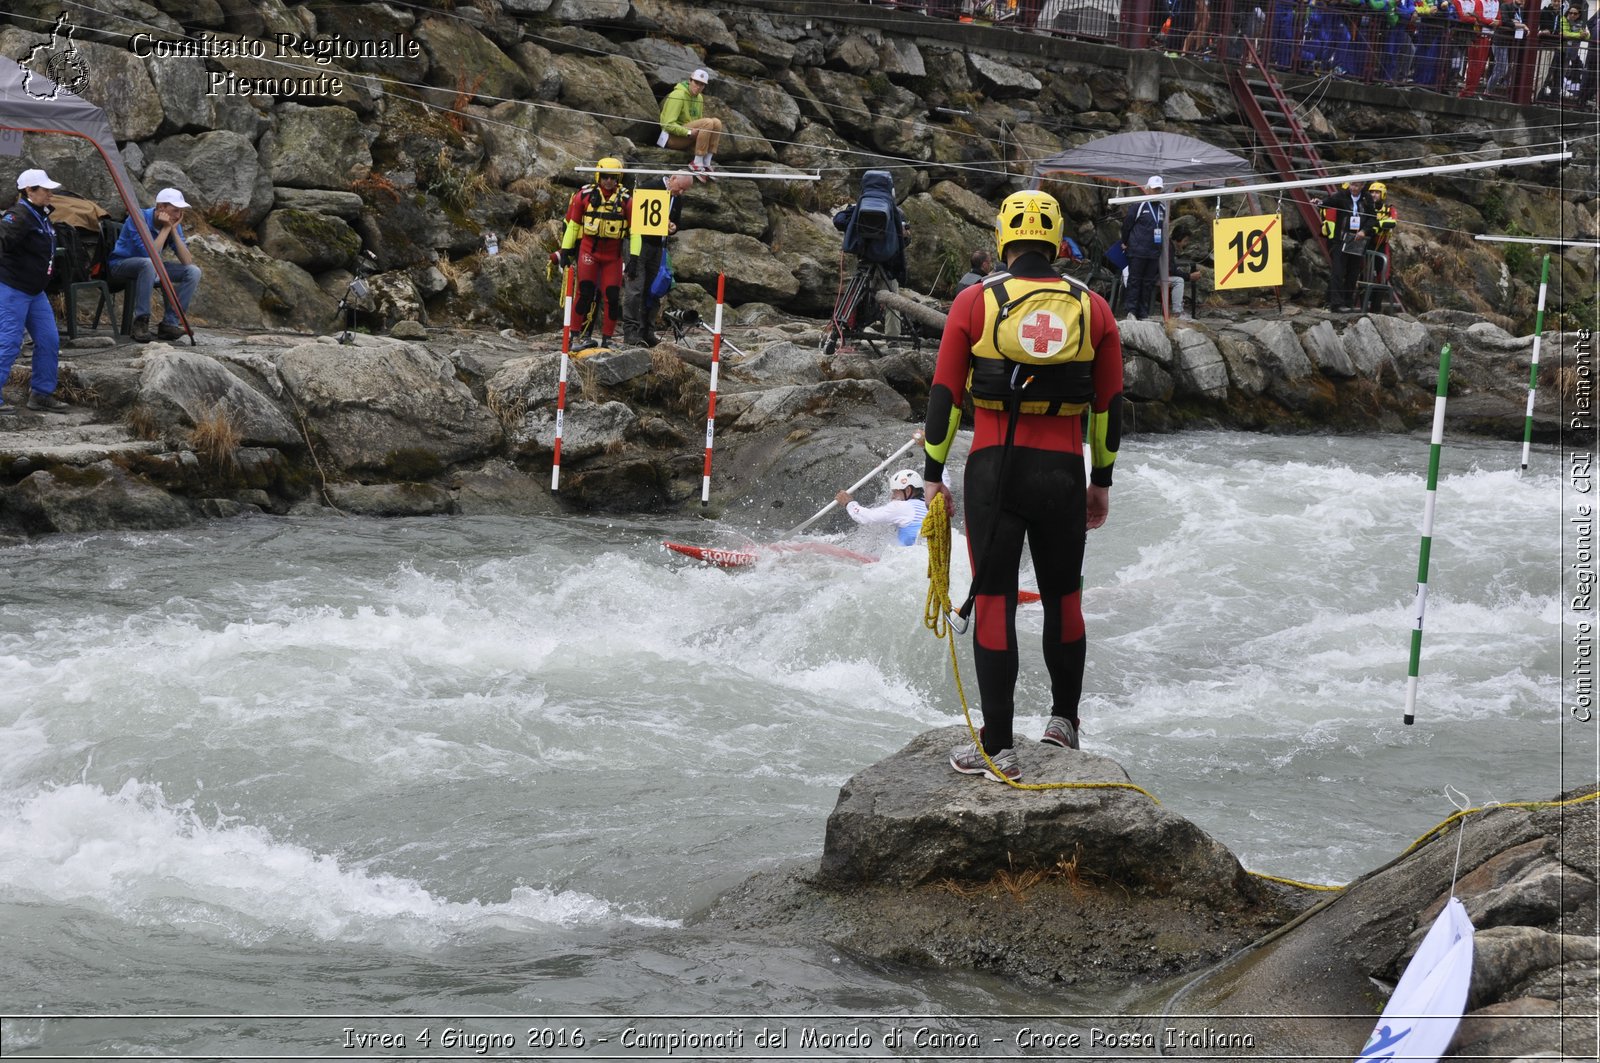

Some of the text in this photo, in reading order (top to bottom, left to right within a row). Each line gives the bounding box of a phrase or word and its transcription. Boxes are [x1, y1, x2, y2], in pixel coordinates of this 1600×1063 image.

[640, 199, 662, 227] 18
[1029, 216, 1035, 224] 9
[1228, 229, 1269, 274] 19
